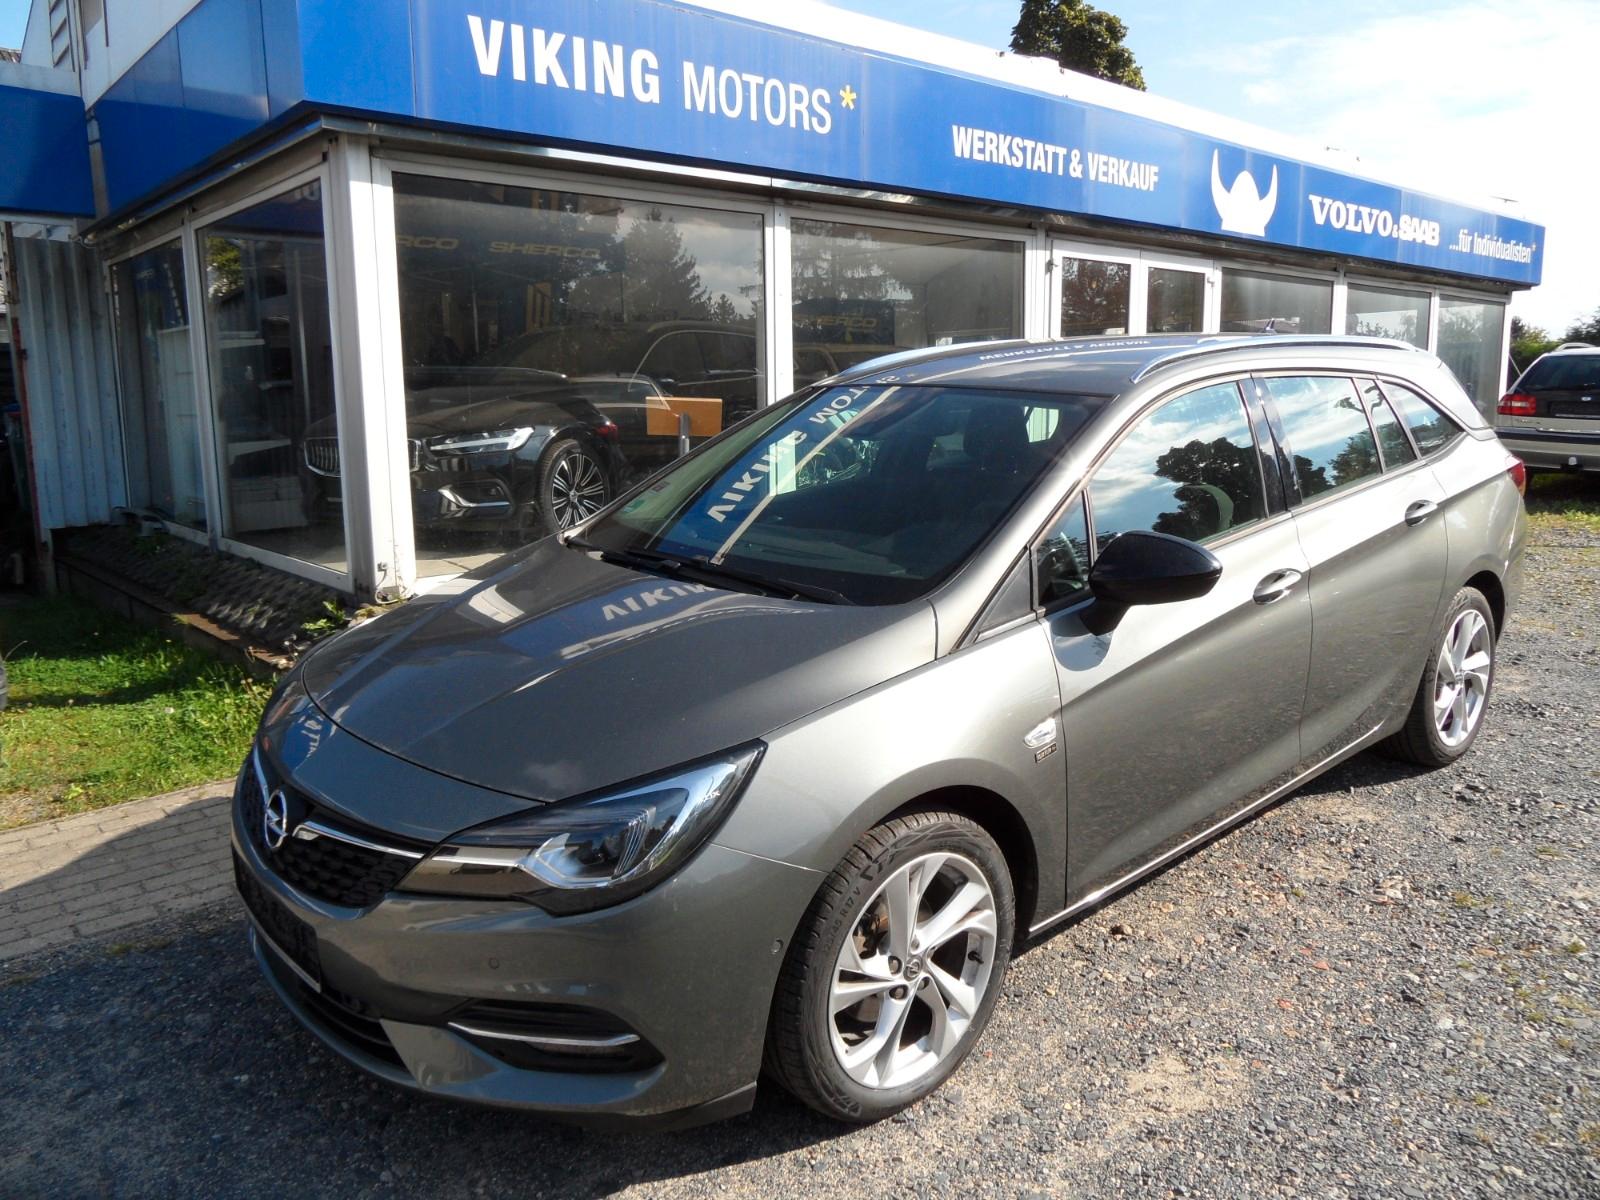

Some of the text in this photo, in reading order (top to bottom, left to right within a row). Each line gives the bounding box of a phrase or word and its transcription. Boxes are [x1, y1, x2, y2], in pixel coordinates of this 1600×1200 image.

[467, 15, 660, 104] VIKING
[952, 125, 1159, 192] WERKSTATT & VERKAUF
[396, 235, 459, 250] RCO
[1308, 194, 1393, 237] VOLVO
[1399, 213, 1441, 247] SAAB
[488, 240, 601, 260] SHERCO
